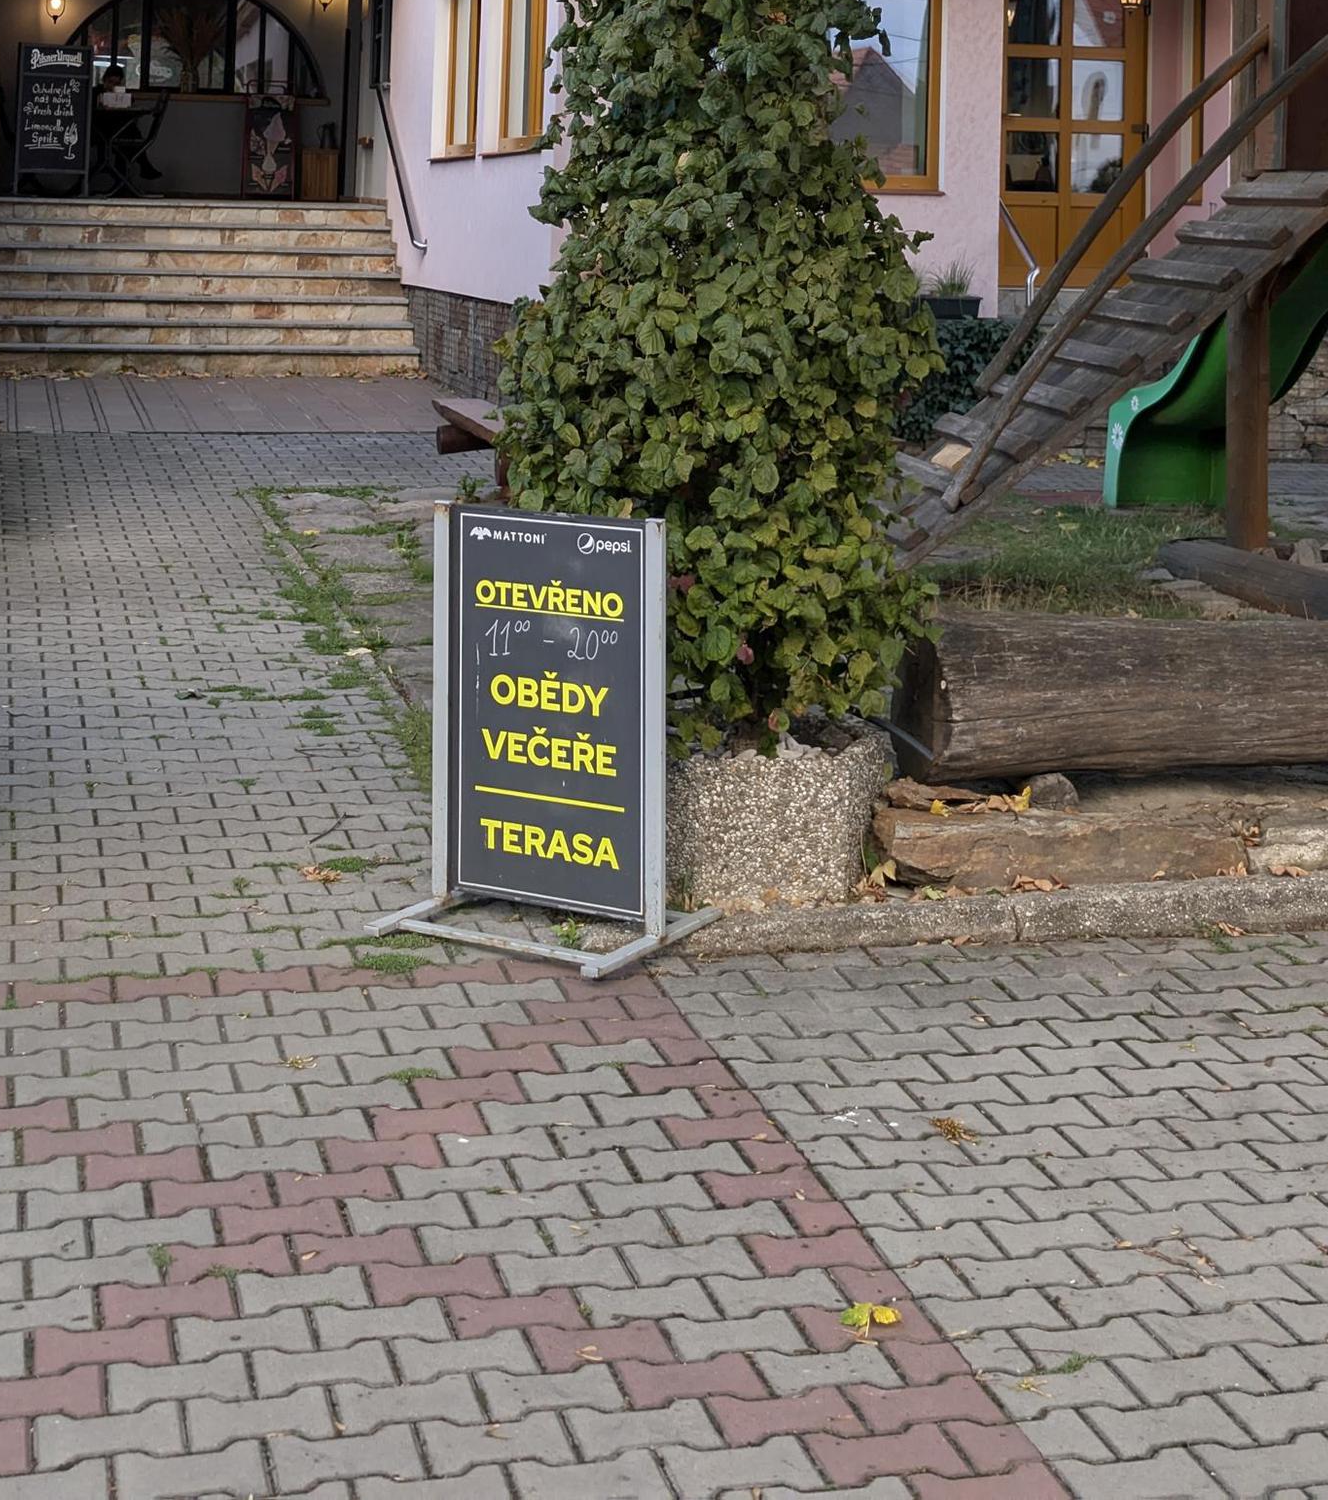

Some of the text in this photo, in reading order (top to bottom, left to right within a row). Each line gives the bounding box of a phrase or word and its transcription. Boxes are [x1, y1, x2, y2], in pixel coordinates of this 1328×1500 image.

[31, 49, 83, 69] Pilsner Urquell
[52, 94, 72, 107] nový
[33, 104, 74, 116] fresh drink
[24, 119, 64, 131] Limoncello
[32, 132, 59, 147] Spritz
[493, 530, 545, 545] MATTONI
[596, 537, 631, 554] pepsi
[475, 579, 624, 617] OTEVŘENO
[490, 671, 609, 717] OBĚDY
[481, 726, 618, 777] VEČEŘE
[480, 818, 620, 870] TERASA
